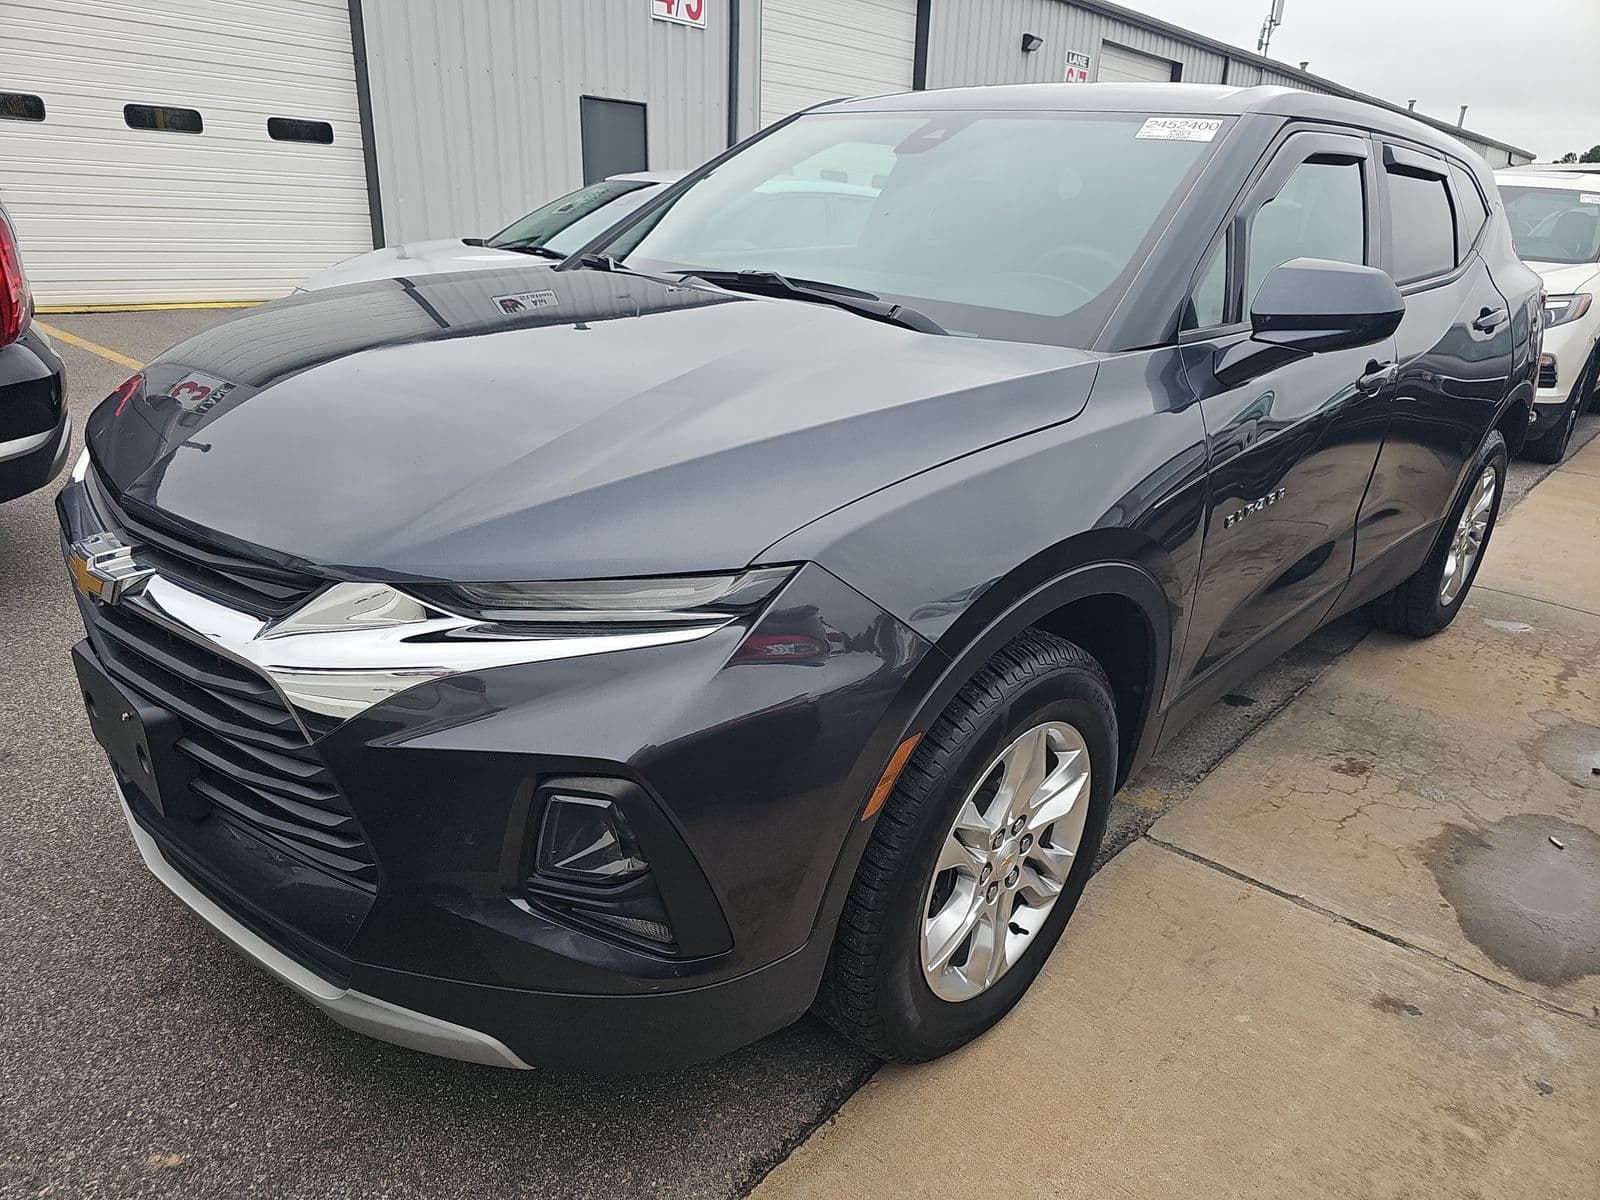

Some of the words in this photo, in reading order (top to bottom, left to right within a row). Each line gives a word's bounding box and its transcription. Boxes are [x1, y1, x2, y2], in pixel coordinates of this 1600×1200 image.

[1069, 52, 1088, 67] LANE
[1146, 120, 1220, 131] 2452400
[1223, 487, 1286, 529] BLAZER
